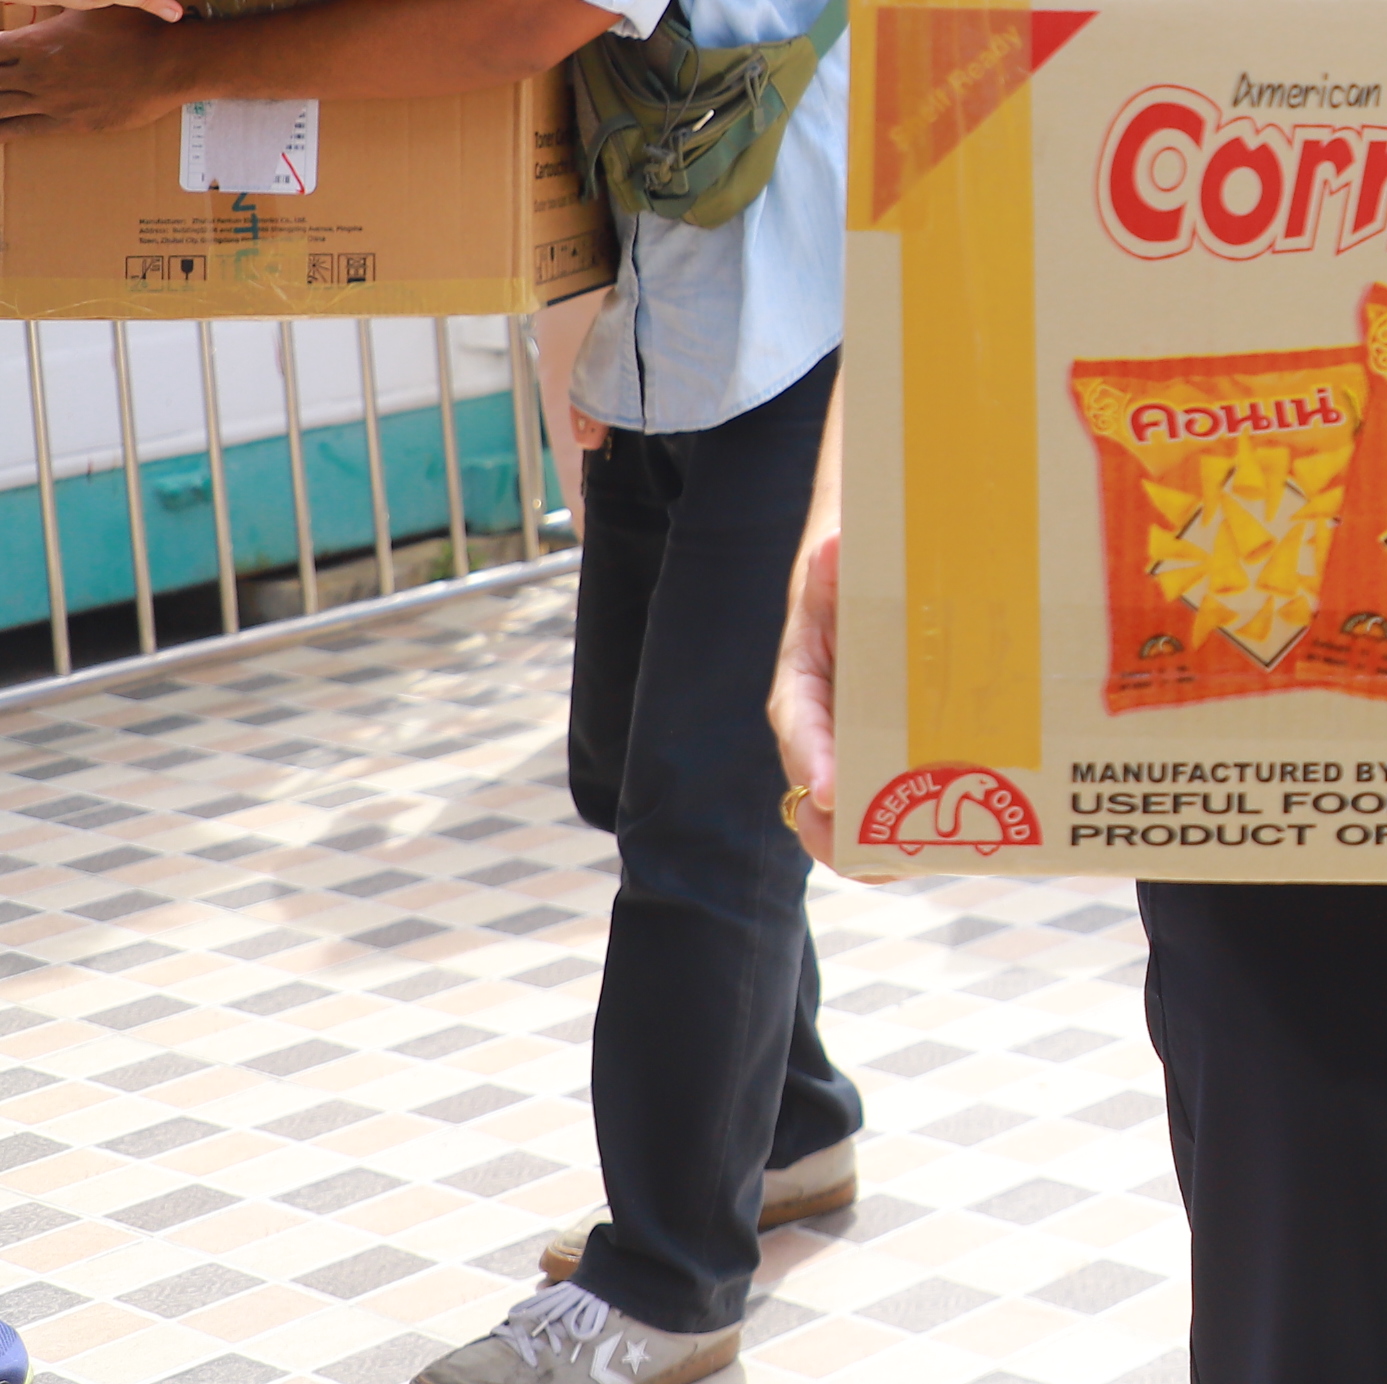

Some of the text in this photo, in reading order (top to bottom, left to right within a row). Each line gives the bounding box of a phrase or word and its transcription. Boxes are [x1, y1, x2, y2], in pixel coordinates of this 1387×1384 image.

[1231, 71, 1381, 111] American
[1128, 387, 1347, 445] คอนเน่
[1071, 761, 1346, 784] MANUFACTURED
[869, 772, 943, 840] USEFUL
[1071, 791, 1263, 815] USEFUL
[1071, 823, 1315, 846] PRODUCT
